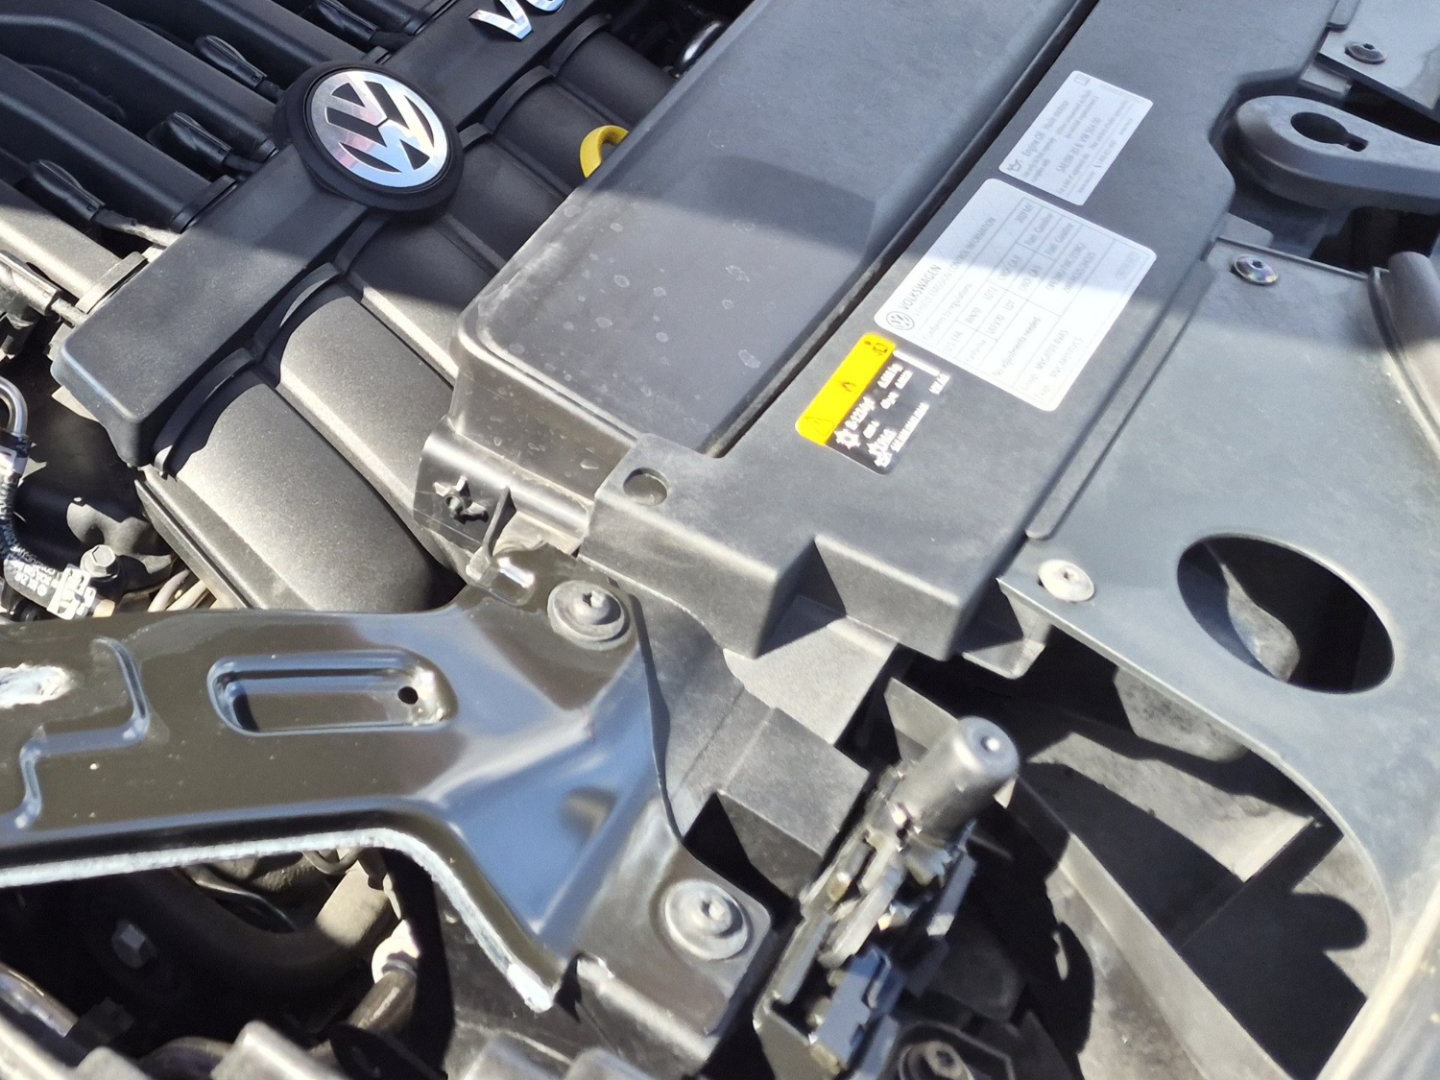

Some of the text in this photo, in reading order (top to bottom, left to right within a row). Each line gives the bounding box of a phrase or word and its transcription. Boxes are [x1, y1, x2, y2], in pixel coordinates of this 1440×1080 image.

[946, 248, 971, 273] CONTROL
[963, 215, 997, 251] INFORMATION
[897, 262, 943, 312] VOLKSWAGEN
